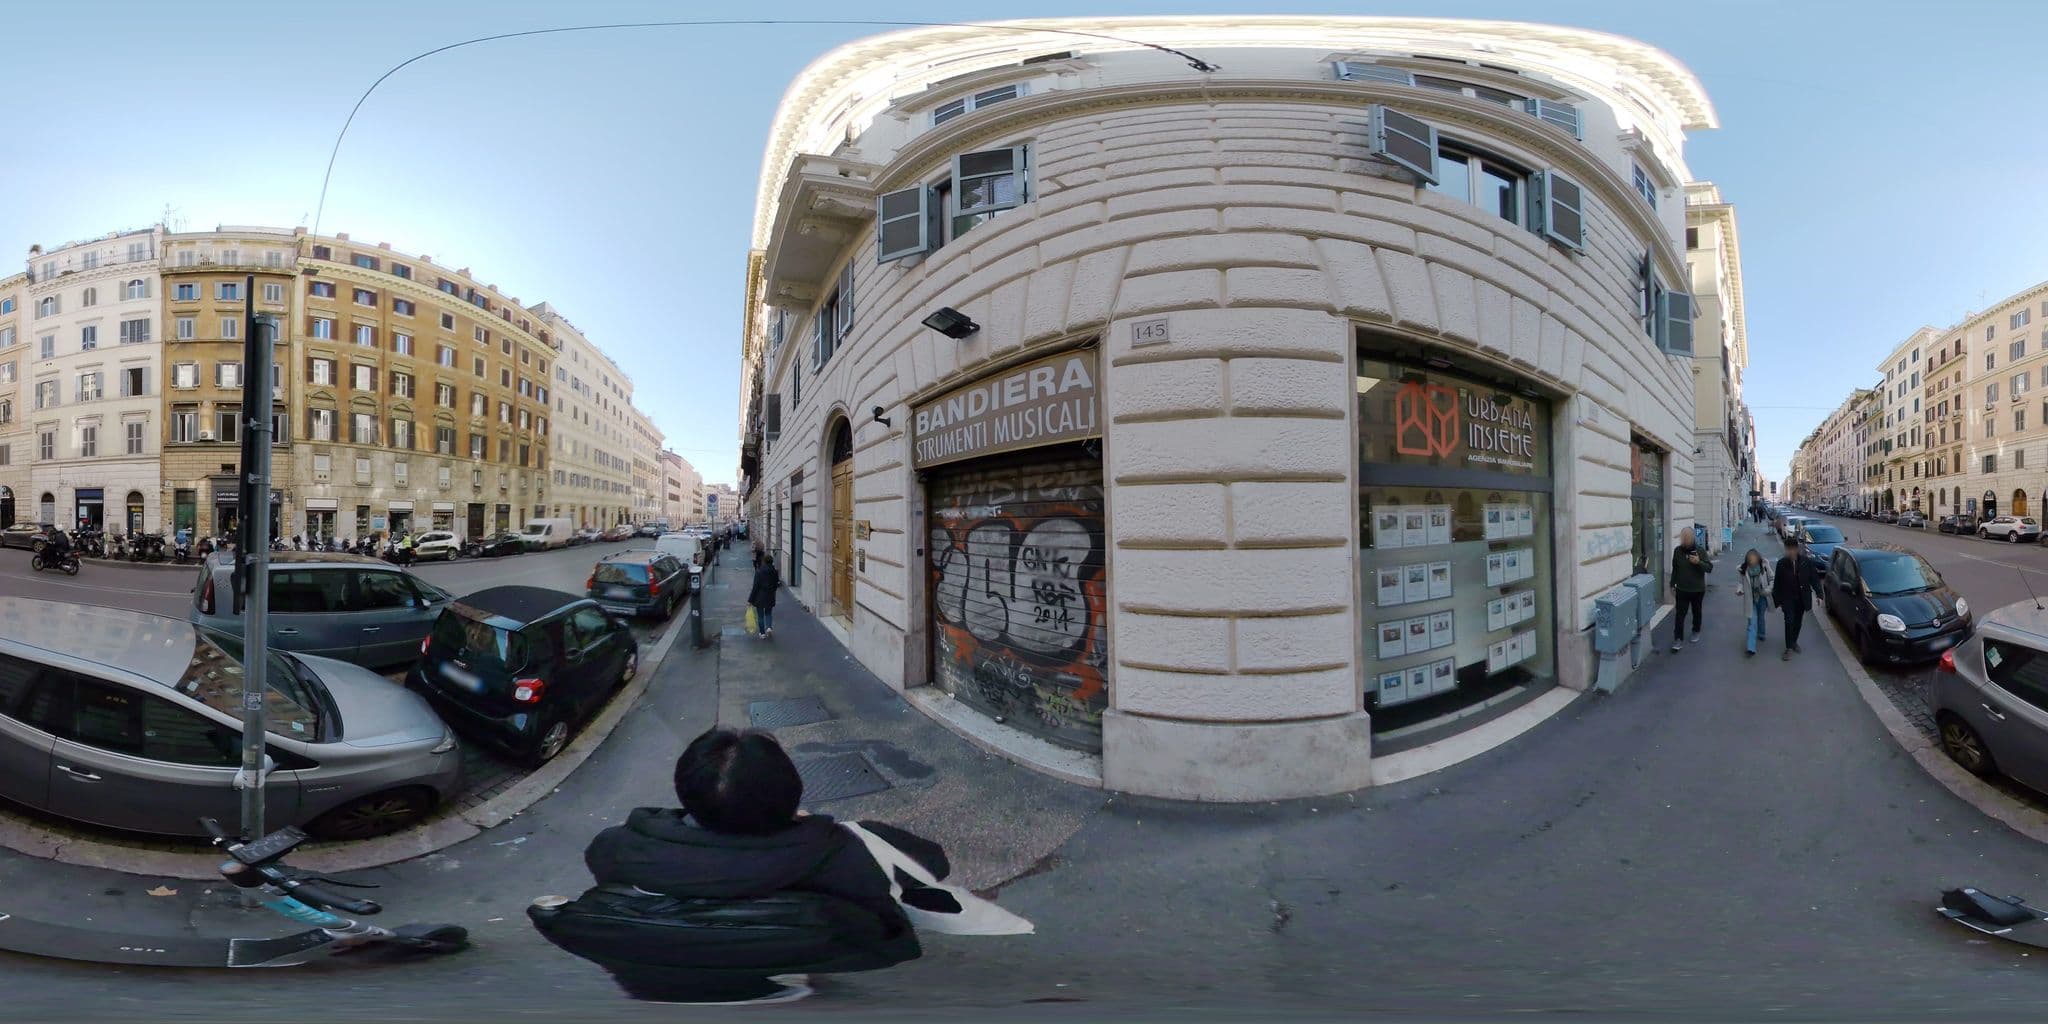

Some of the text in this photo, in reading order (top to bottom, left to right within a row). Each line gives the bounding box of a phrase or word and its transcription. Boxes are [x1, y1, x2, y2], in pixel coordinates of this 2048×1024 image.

[1136, 324, 1165, 339] 145
[916, 357, 1092, 437] BANDIERA
[1468, 394, 1533, 432] URBANA
[916, 396, 1096, 464] STRUMENTI MUSICALI
[1468, 422, 1533, 457] INSIEME
[1033, 606, 1075, 632] 2014
